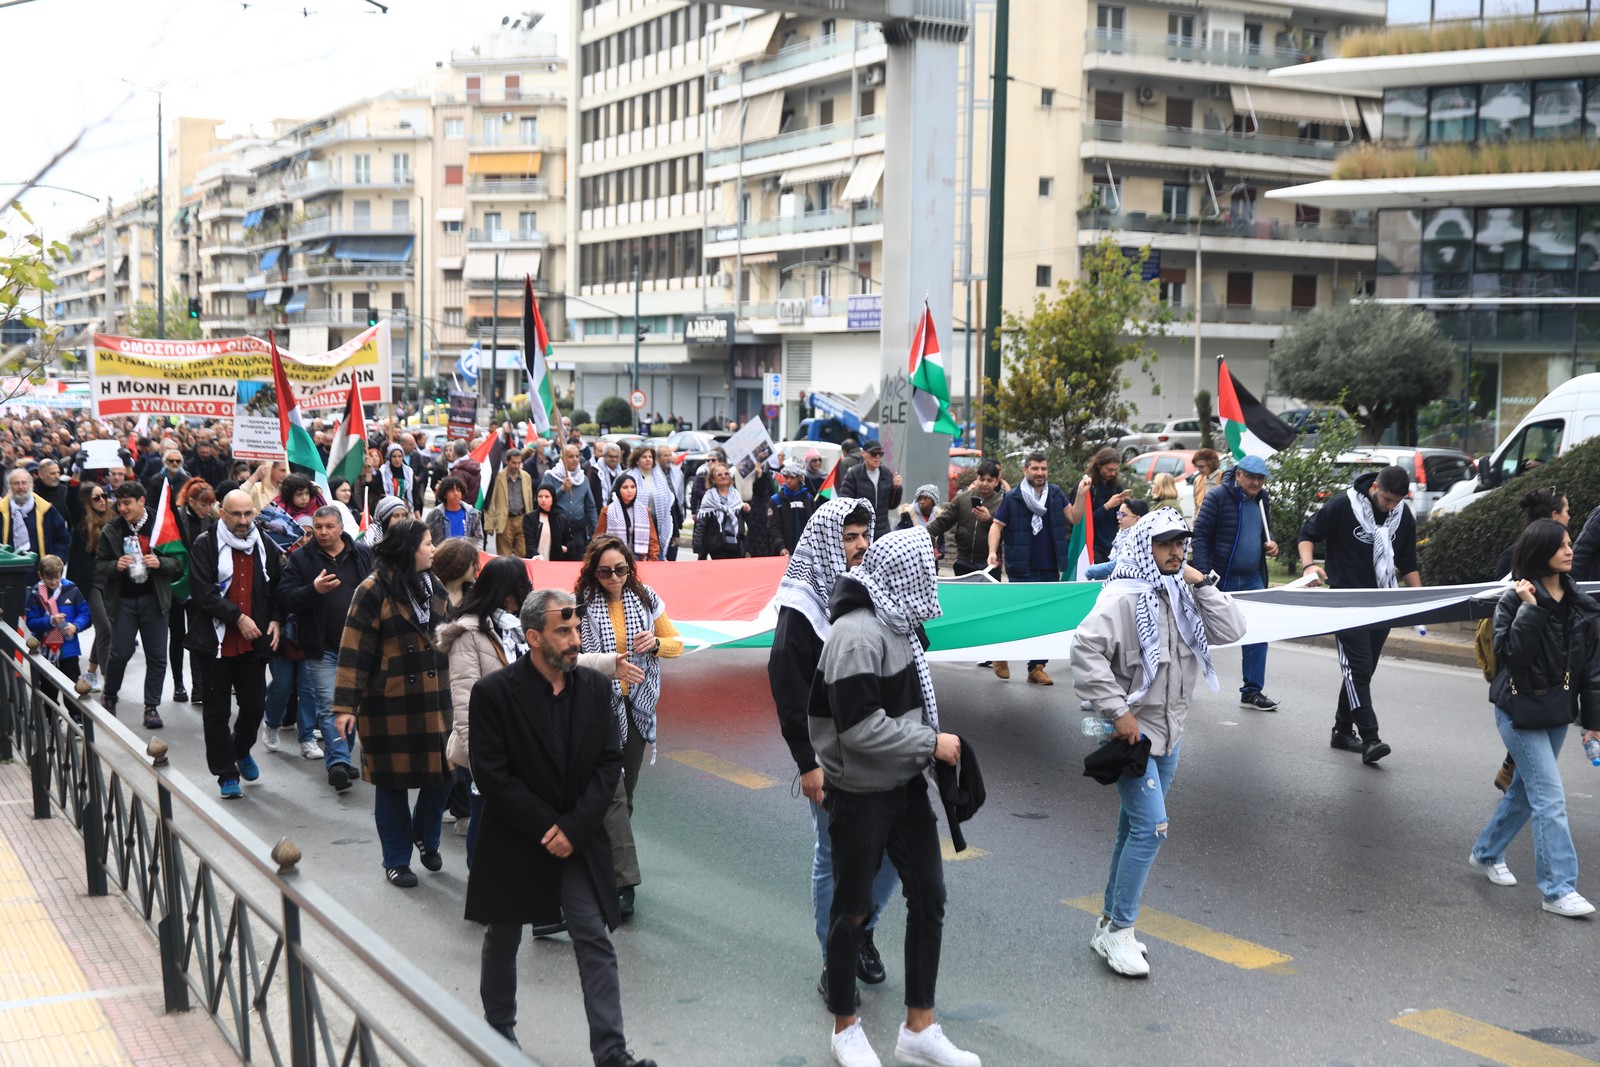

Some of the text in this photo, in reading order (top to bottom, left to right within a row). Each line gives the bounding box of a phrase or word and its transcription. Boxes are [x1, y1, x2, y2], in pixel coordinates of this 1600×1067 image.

[120, 340, 221, 355] ΟΜΟΣΠΟΝΔΙΑ
[100, 353, 113, 361] ΝΑ
[117, 357, 184, 371] ΣΤΑΜΑΤΗΣΕΙ
[189, 360, 213, 369] ΤΩΡΑ
[163, 370, 208, 380] ΕΝΑΝΤΙΑ
[211, 368, 240, 378] ΣΤΟΝ
[101, 381, 111, 394] Η
[118, 380, 170, 395] ΜΟΝΗ
[131, 400, 216, 415] ΣΥΝΔΙΚΑΤΟ
[882, 401, 907, 424] SLE
